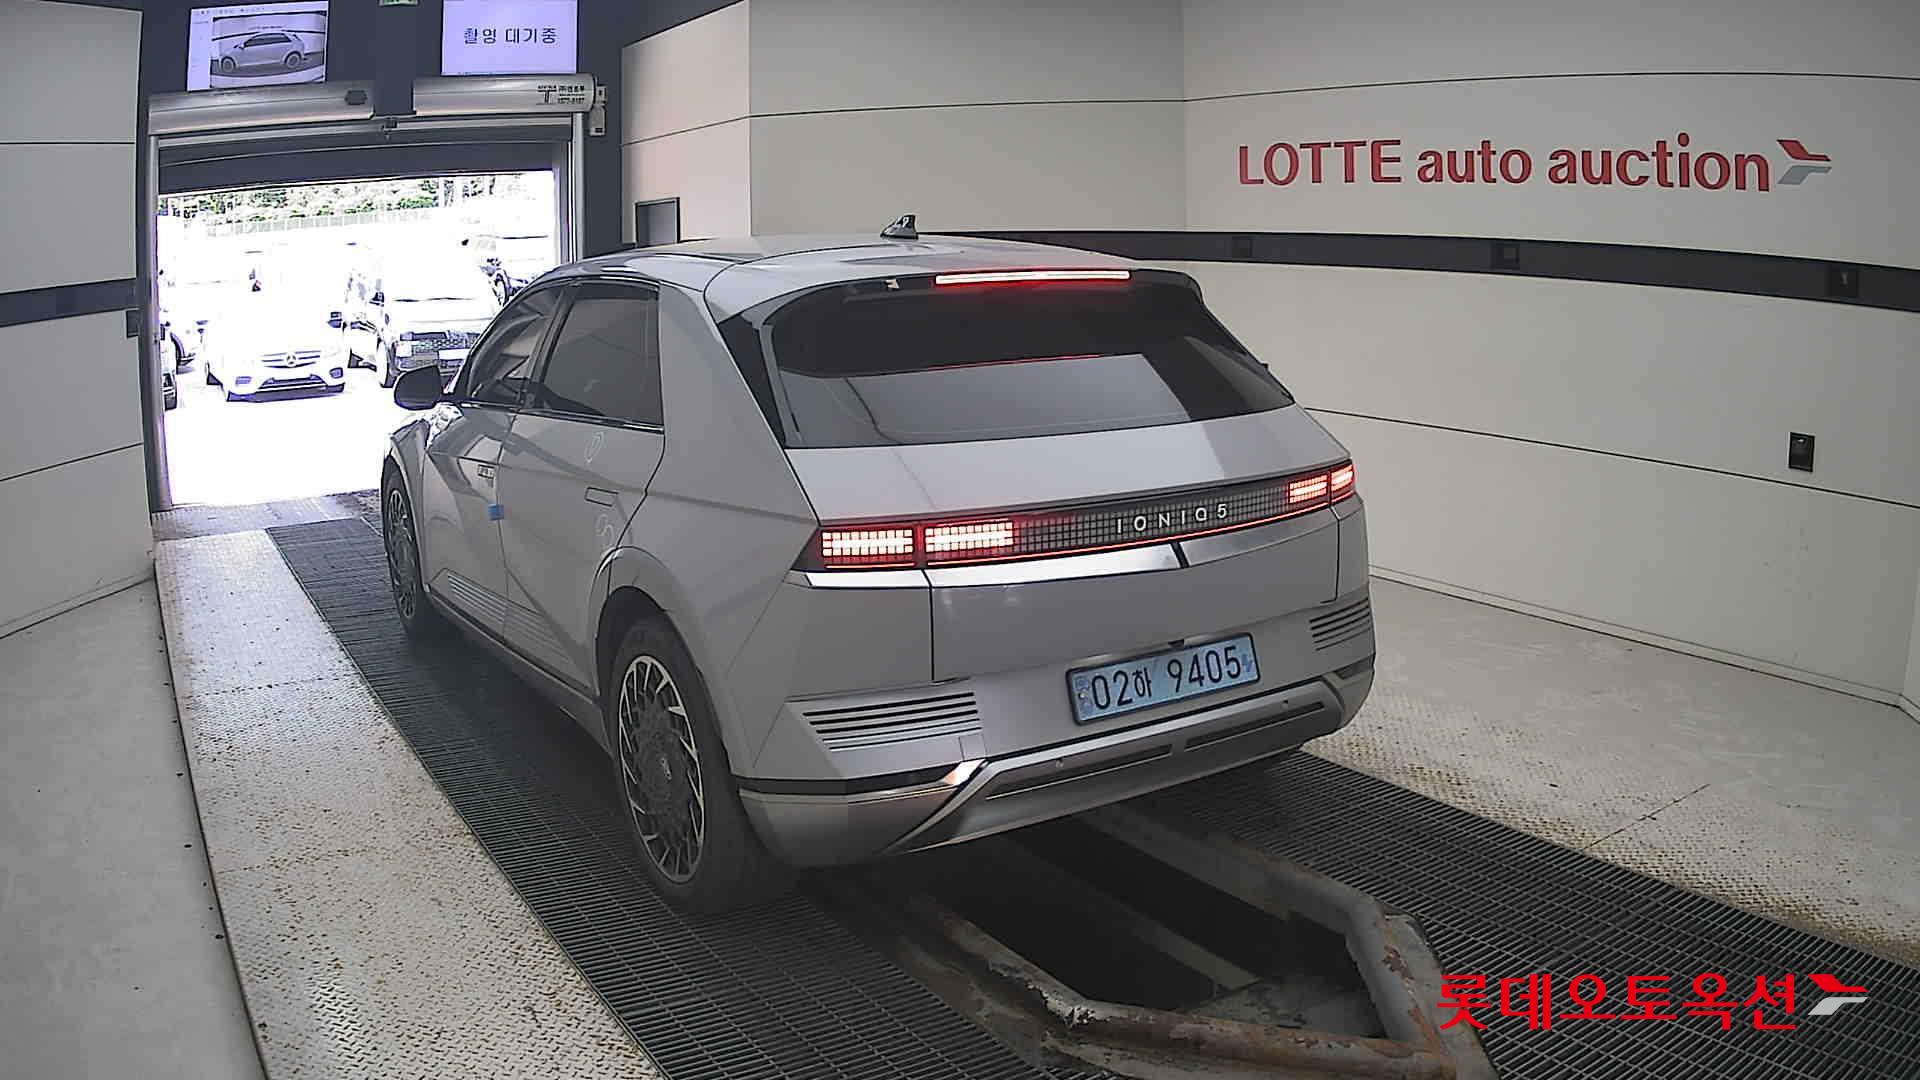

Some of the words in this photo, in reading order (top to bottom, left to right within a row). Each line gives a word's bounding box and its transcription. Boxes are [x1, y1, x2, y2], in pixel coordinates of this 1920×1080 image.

[505, 27, 557, 44] 대기중
[1238, 139, 1402, 186] LOTTE
[1416, 140, 1532, 184] auto
[1548, 132, 1770, 192] auction
[1091, 667, 1152, 710] 02하
[1167, 646, 1241, 693] 9405
